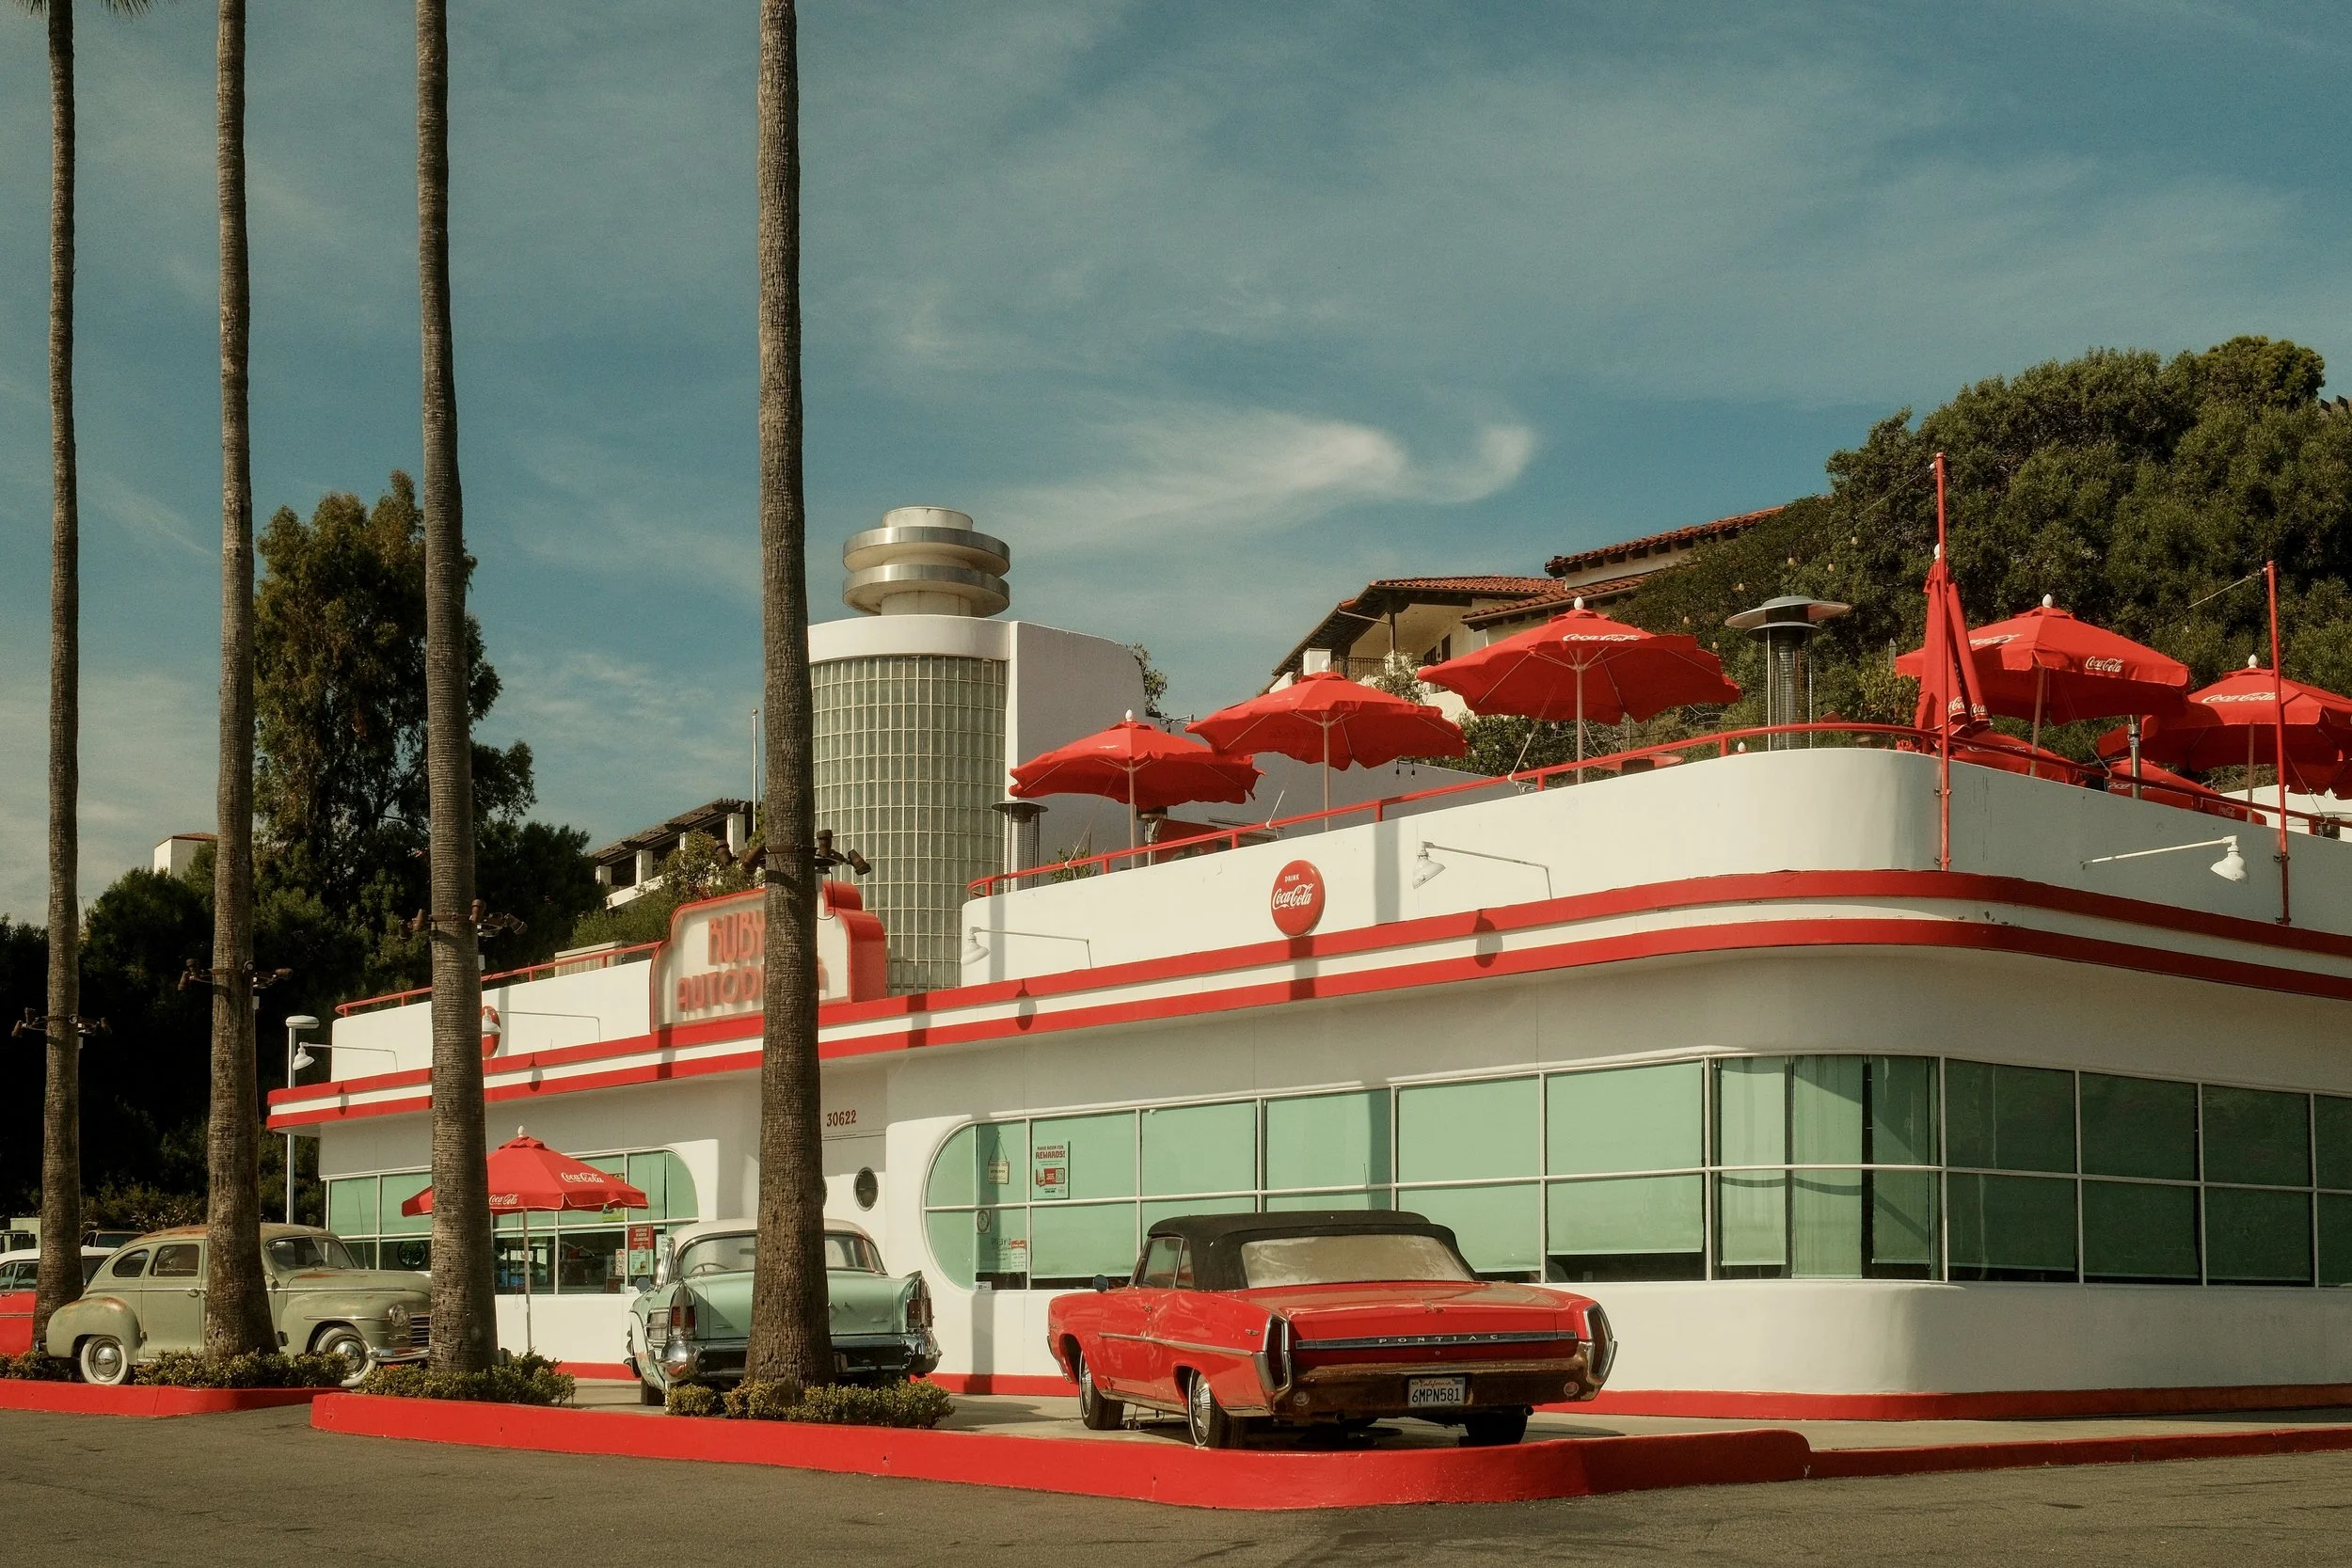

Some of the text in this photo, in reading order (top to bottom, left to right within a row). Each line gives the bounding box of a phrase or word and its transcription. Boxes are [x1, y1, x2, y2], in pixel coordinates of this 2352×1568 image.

[2085, 656, 2124, 673] Coca-Cola
[1285, 874, 1299, 882] DRINK
[1273, 883, 1314, 910] Coca-Cola
[826, 1109, 857, 1127] 30622
[1035, 1150, 1066, 1160] REWARDS!
[561, 1172, 604, 1183] Coca-Cola
[488, 1194, 519, 1205] Coca-Cola
[1378, 1335, 1498, 1344] PONTIAC
[1412, 1387, 1460, 1402] 6MPN581
